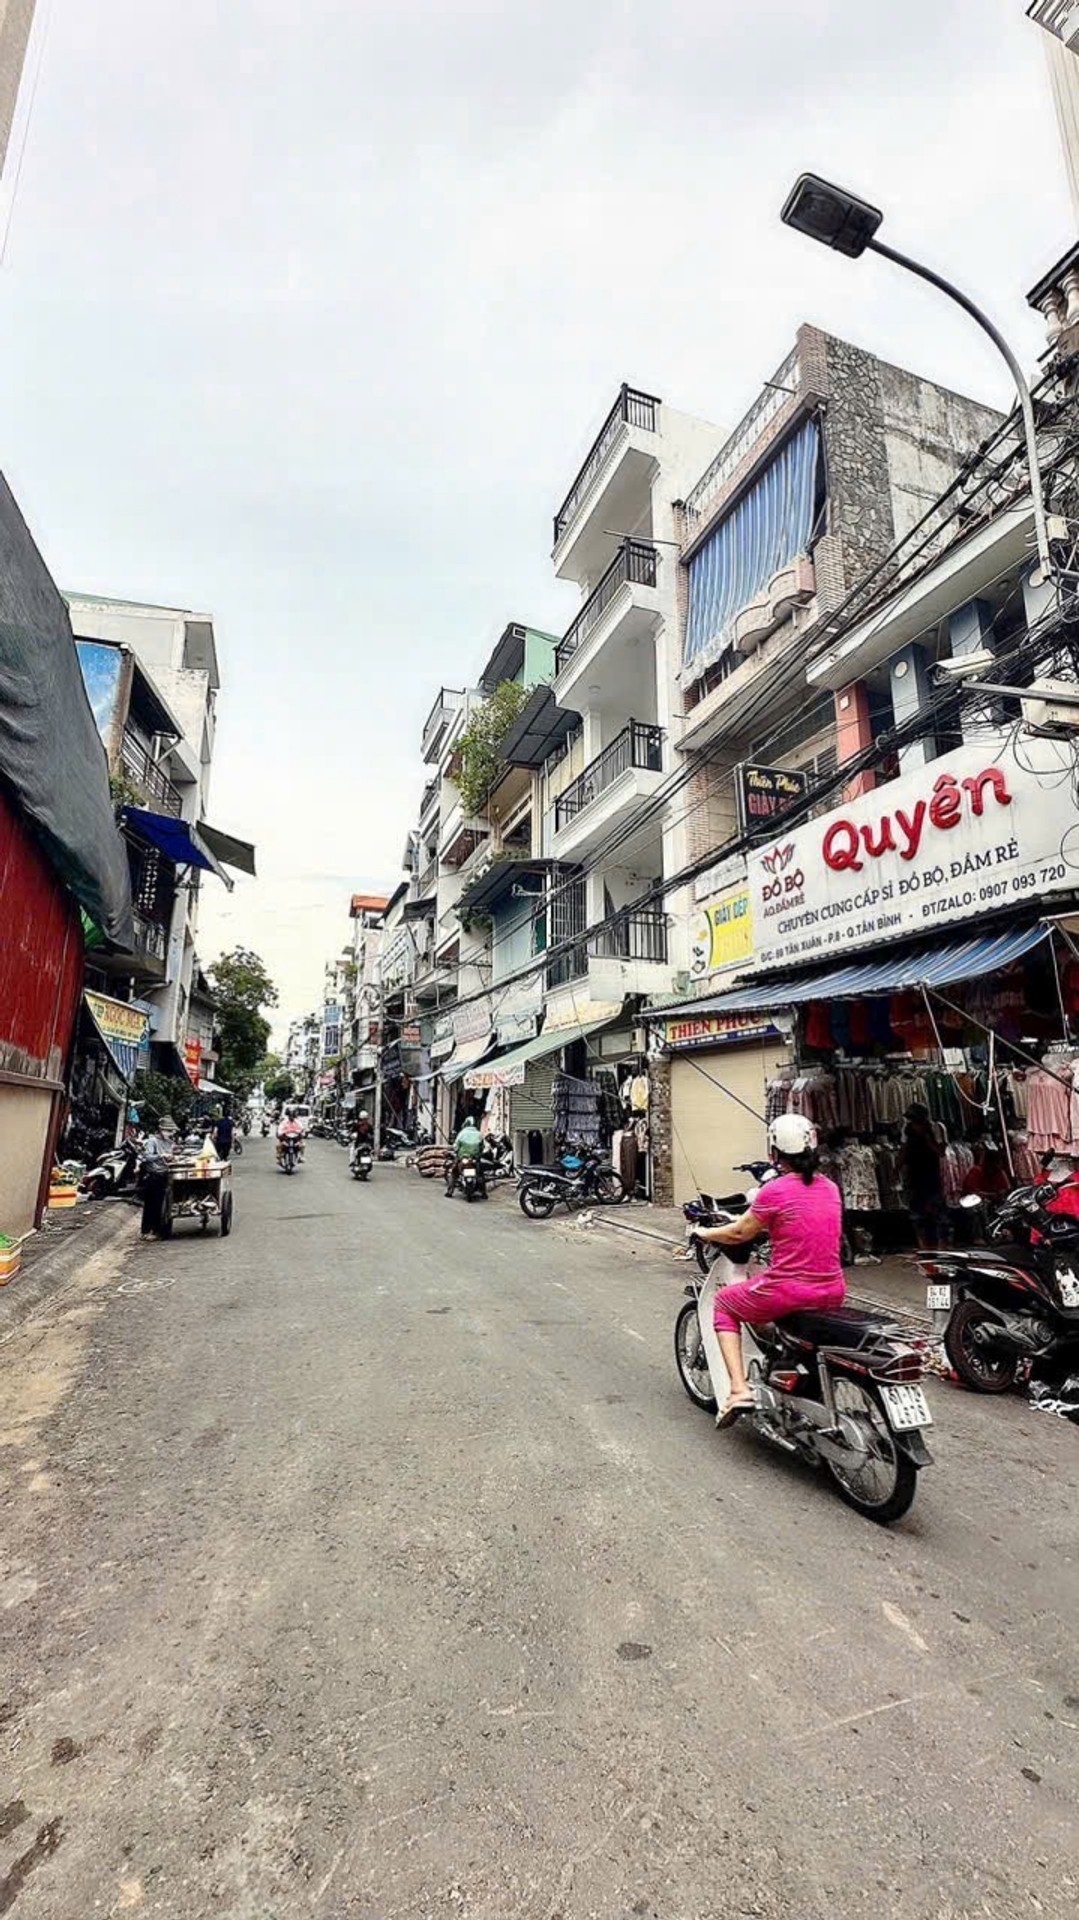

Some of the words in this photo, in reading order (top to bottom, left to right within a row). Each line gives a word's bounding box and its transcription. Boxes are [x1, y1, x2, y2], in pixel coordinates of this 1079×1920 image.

[822, 768, 1012, 871] Quyên
[778, 910, 819, 934] CHUYÊN
[820, 898, 853, 920] CUNG
[853, 886, 880, 909] CẤP
[995, 837, 1019, 864] RẺ
[877, 912, 902, 930] BÌNH
[922, 892, 976, 917] ĐT/ZALO:
[980, 881, 1008, 901] 0907
[1012, 872, 1036, 891] 093
[1040, 863, 1066, 884] 720
